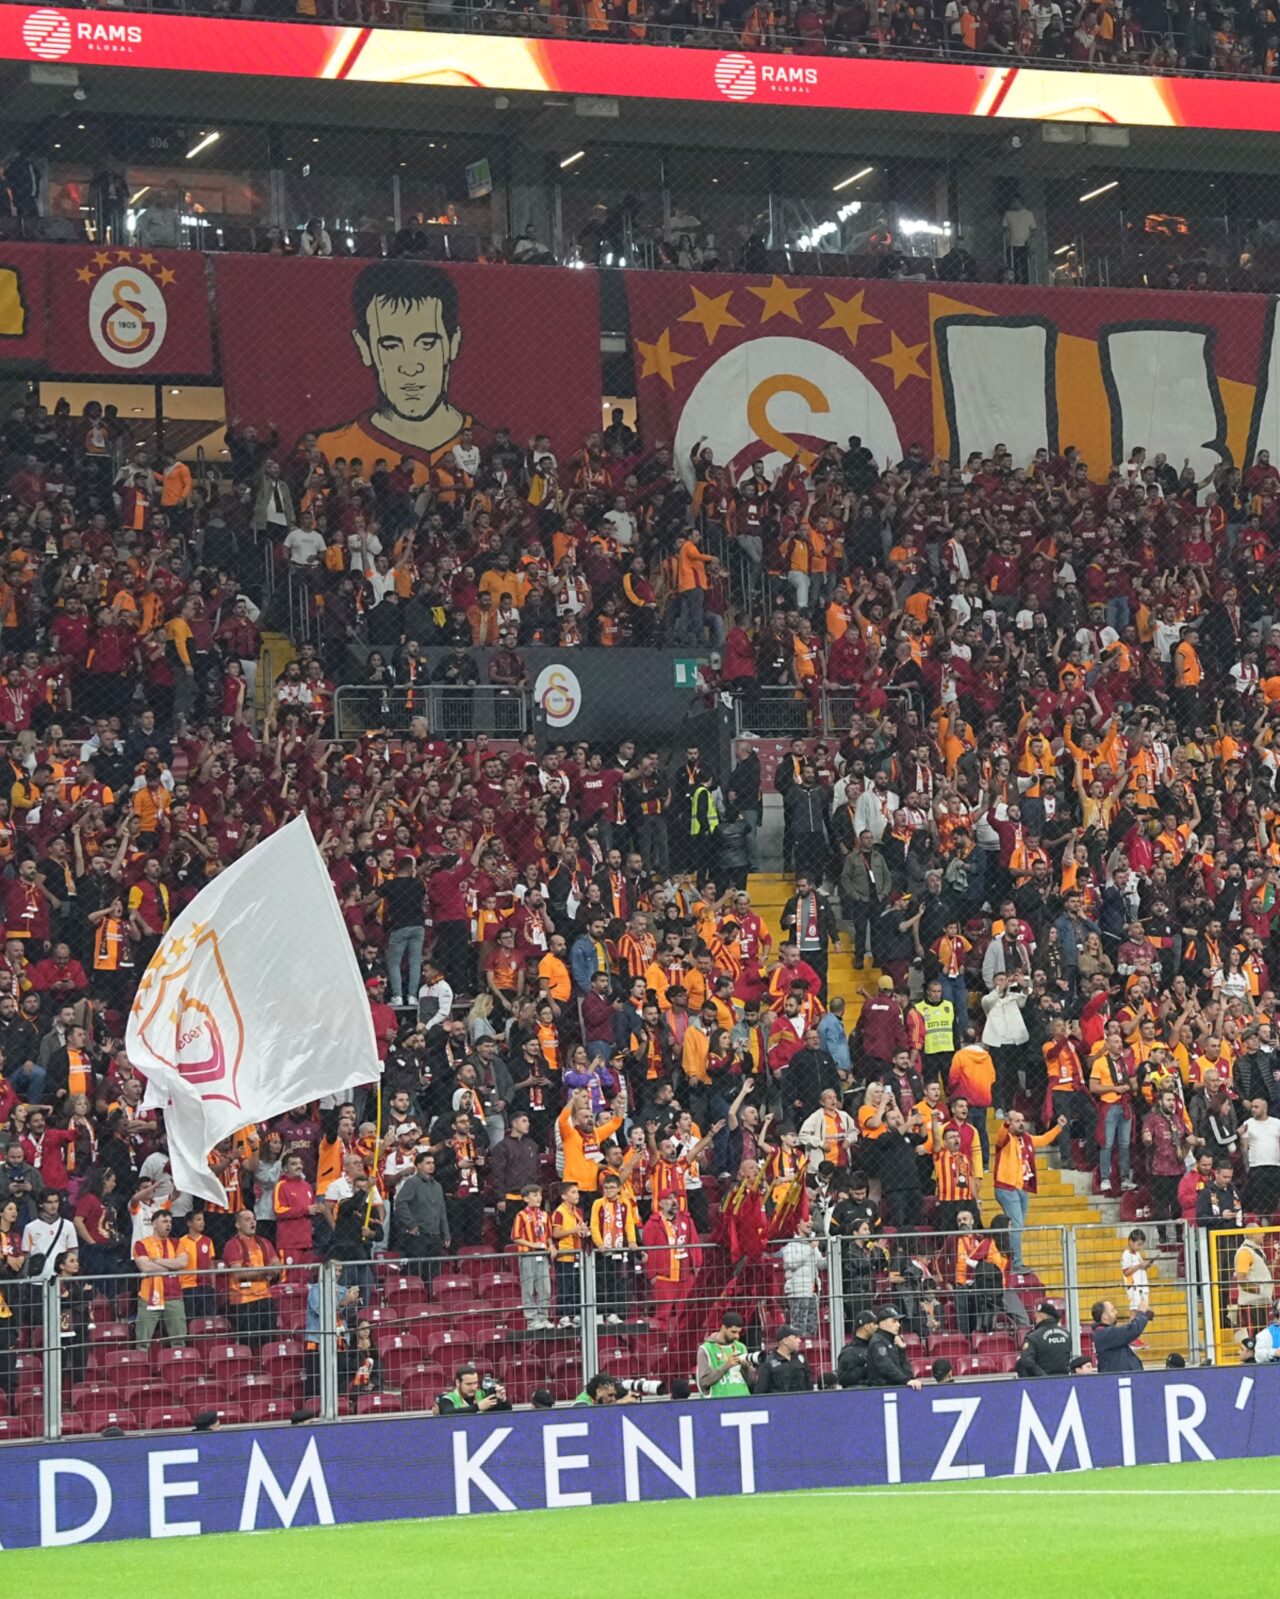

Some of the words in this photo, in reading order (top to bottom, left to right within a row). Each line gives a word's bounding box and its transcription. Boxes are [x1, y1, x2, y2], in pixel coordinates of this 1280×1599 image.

[77, 23, 142, 43] RAMS
[88, 43, 134, 53] GLOBAL
[761, 65, 818, 84] RAMS
[770, 84, 810, 93] GLOBAL
[118, 321, 137, 329] 1905
[0, 1435, 336, 1549] DEM
[452, 1410, 769, 1515] KENT
